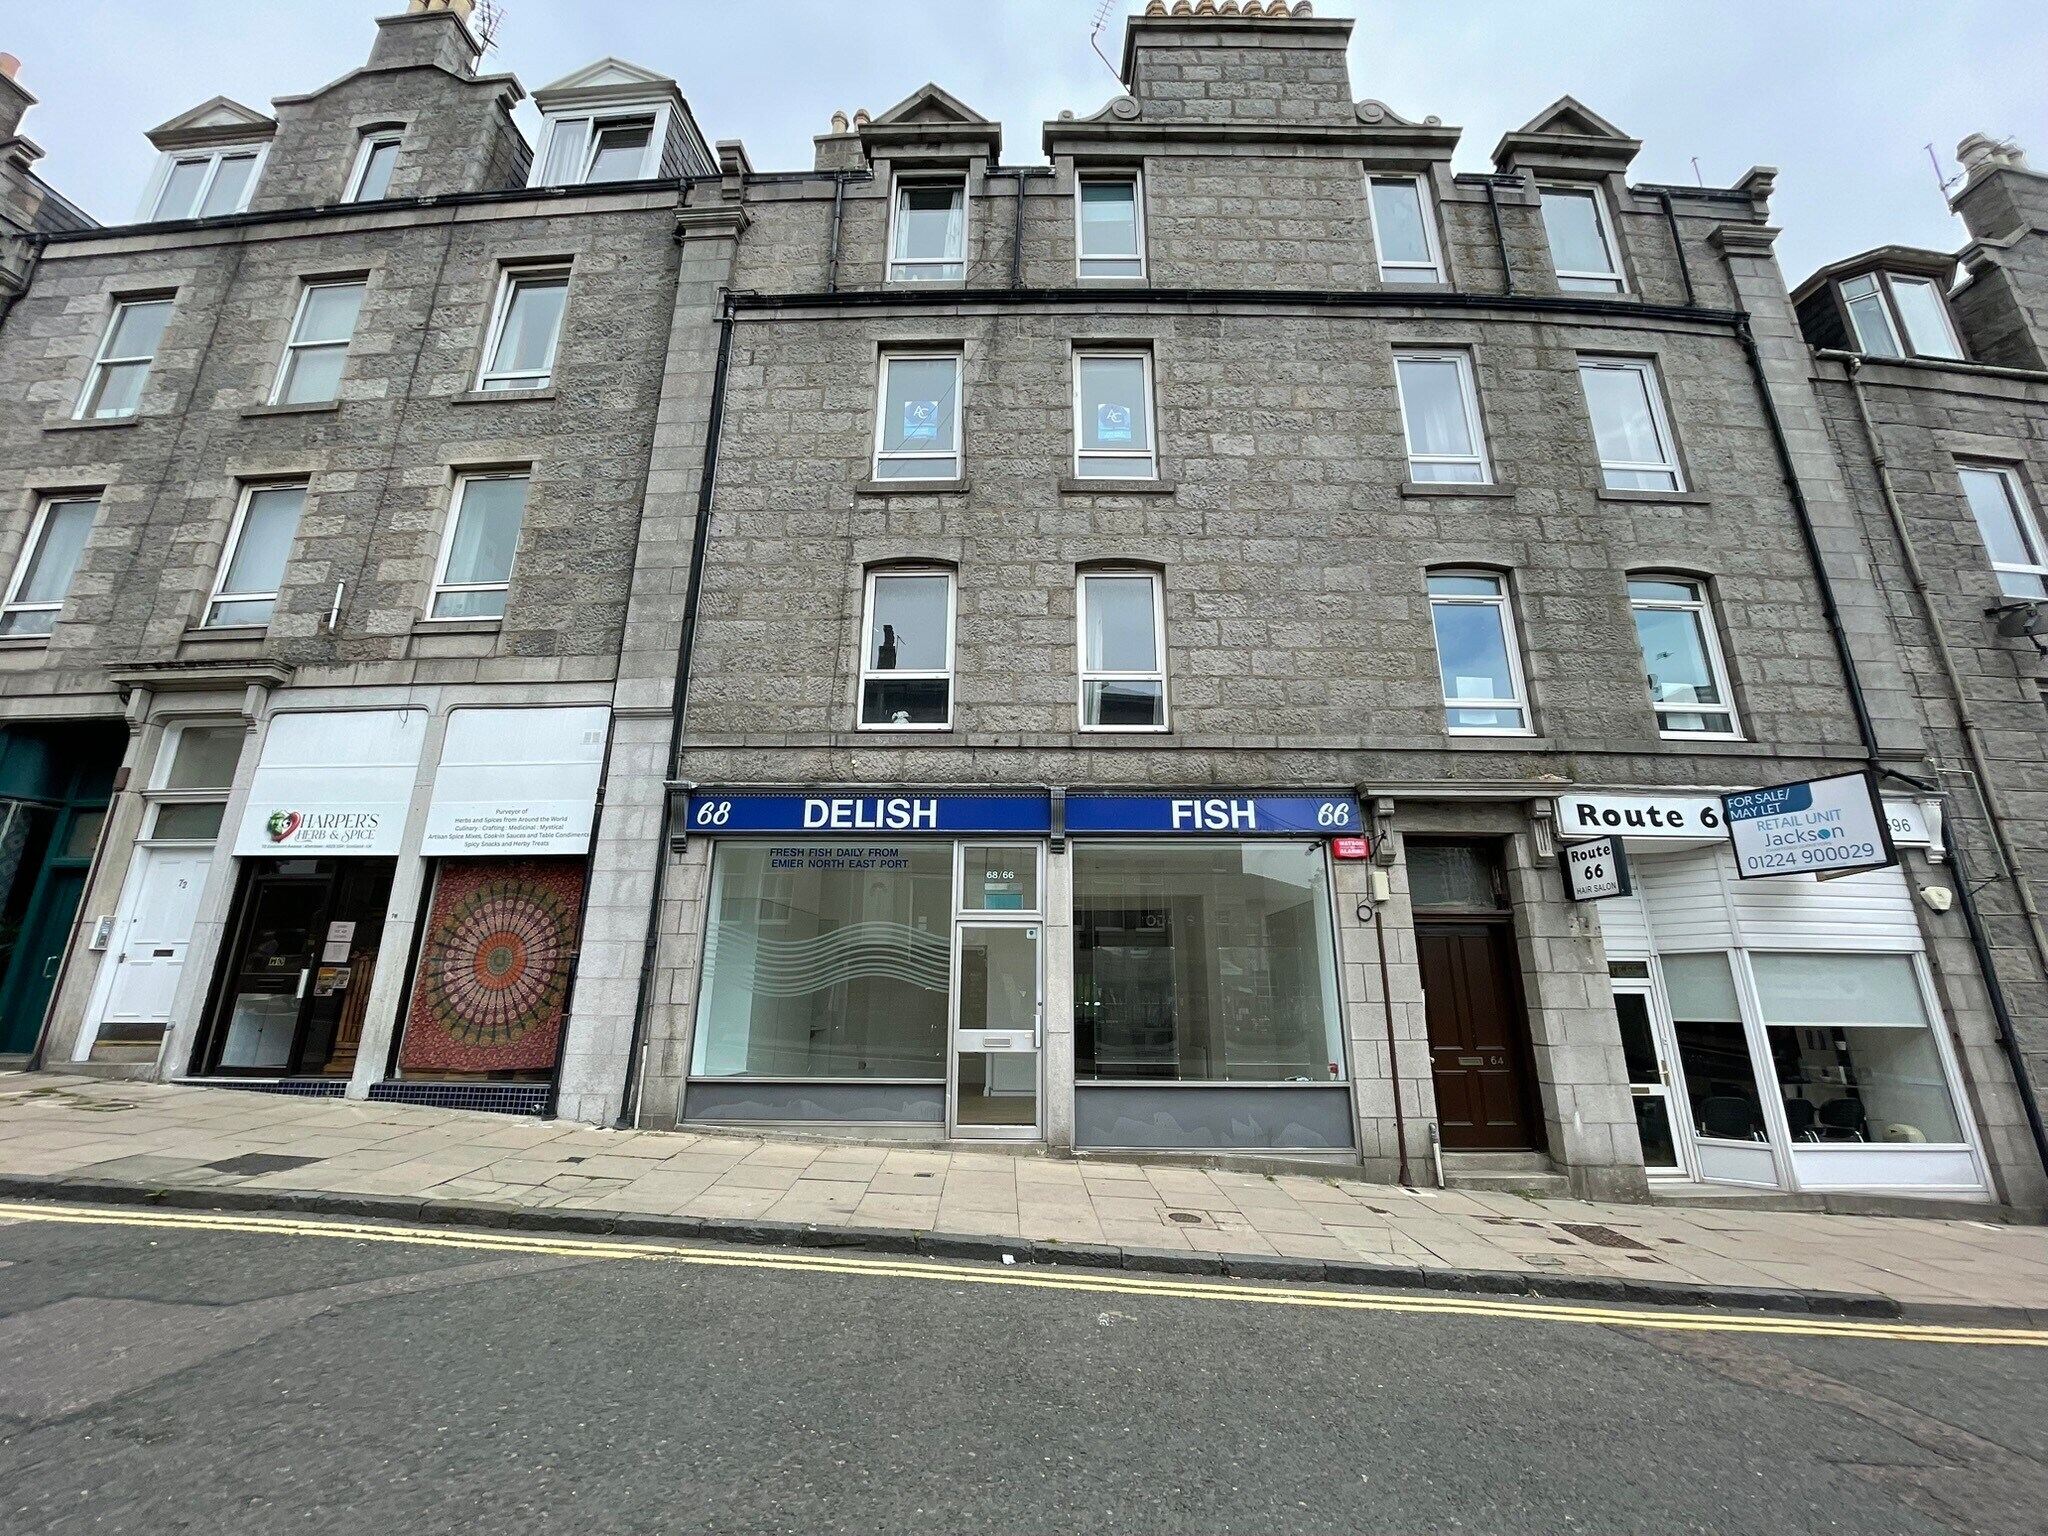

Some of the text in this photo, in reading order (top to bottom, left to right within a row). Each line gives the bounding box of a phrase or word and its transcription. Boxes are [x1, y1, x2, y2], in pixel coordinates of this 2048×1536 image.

[1727, 788, 1790, 809] FOR SALE/
[300, 813, 380, 828] HARPER'S
[696, 798, 937, 828] 68 DELISH
[1171, 799, 1350, 829] FISH 66
[1576, 803, 1728, 828] Route 6
[1730, 804, 1780, 820] MAY LET
[1757, 809, 1842, 832] RETAIL UNIT
[295, 829, 376, 842] HERB & SPICE
[1764, 826, 1845, 847] Jackson
[770, 848, 899, 857] FRESH FISH DAILY FROM
[1571, 845, 1611, 863] Route
[1747, 852, 1797, 869] 01224
[1801, 843, 1874, 863] 900029
[771, 859, 909, 868] EMIER NORTH EAST PORT
[1584, 864, 1604, 880] 66
[986, 871, 1015, 880] 68/66
[1576, 882, 1617, 895] HAIR SALON
